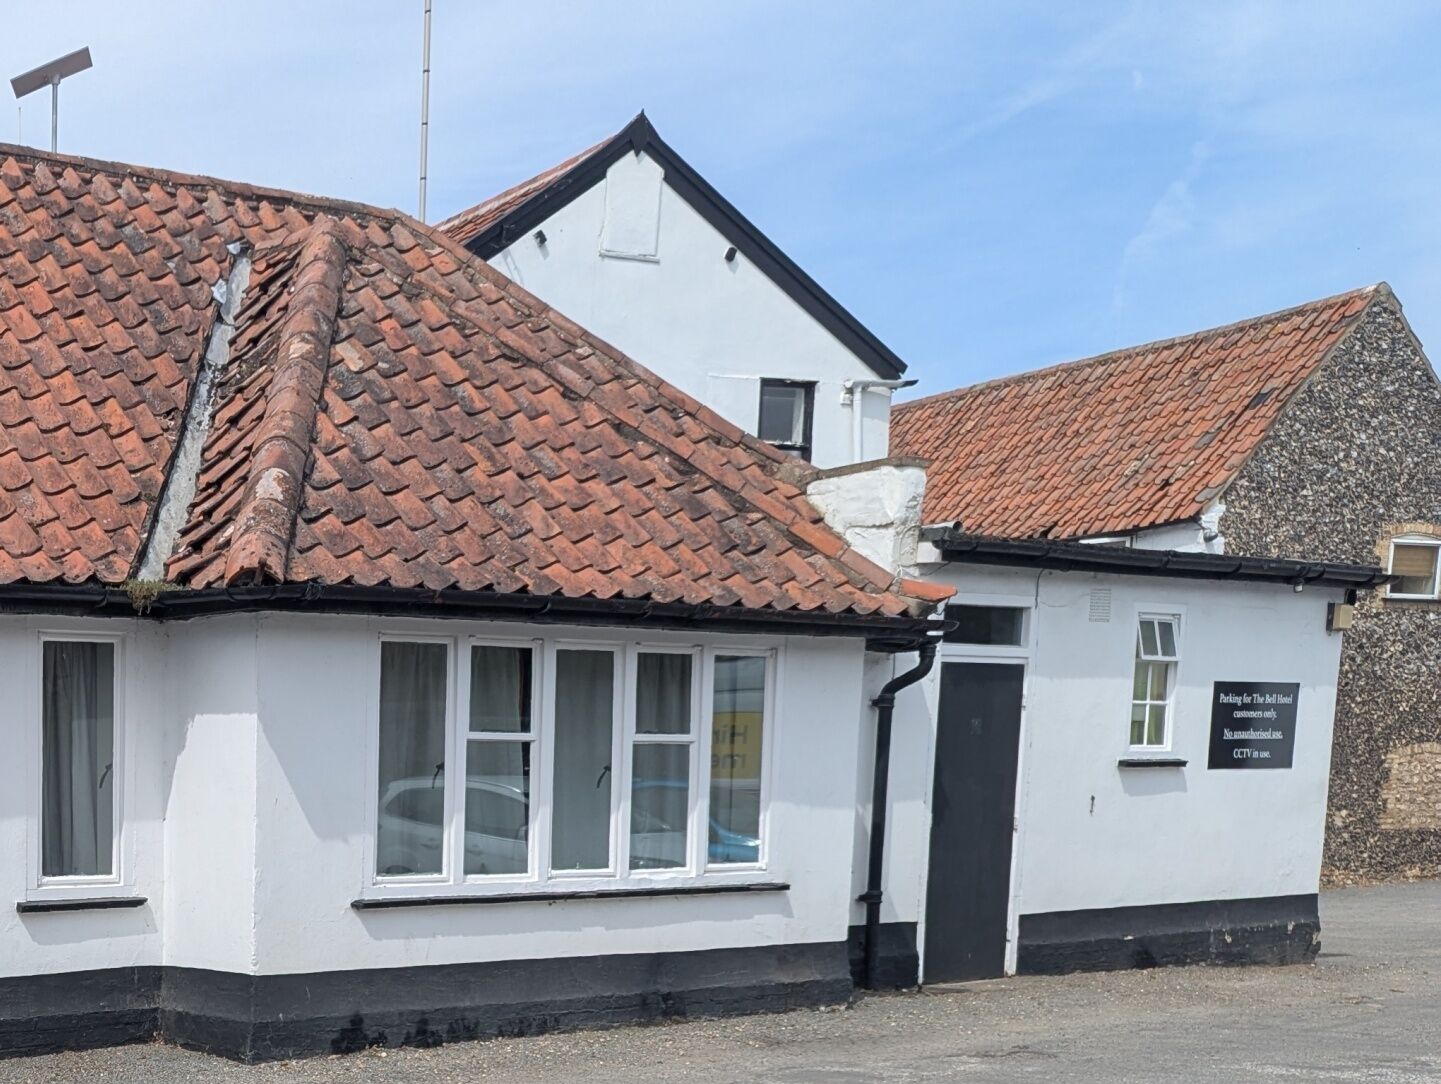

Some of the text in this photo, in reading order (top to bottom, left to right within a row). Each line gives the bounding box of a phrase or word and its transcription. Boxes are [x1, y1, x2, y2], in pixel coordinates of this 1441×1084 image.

[1220, 693, 1293, 706] Parking for The Bell Hotel
[1233, 708, 1277, 720] customers only.
[1223, 728, 1283, 739] No unauthorised use.
[1233, 749, 1252, 758] CCTV
[1252, 749, 1259, 758] in
